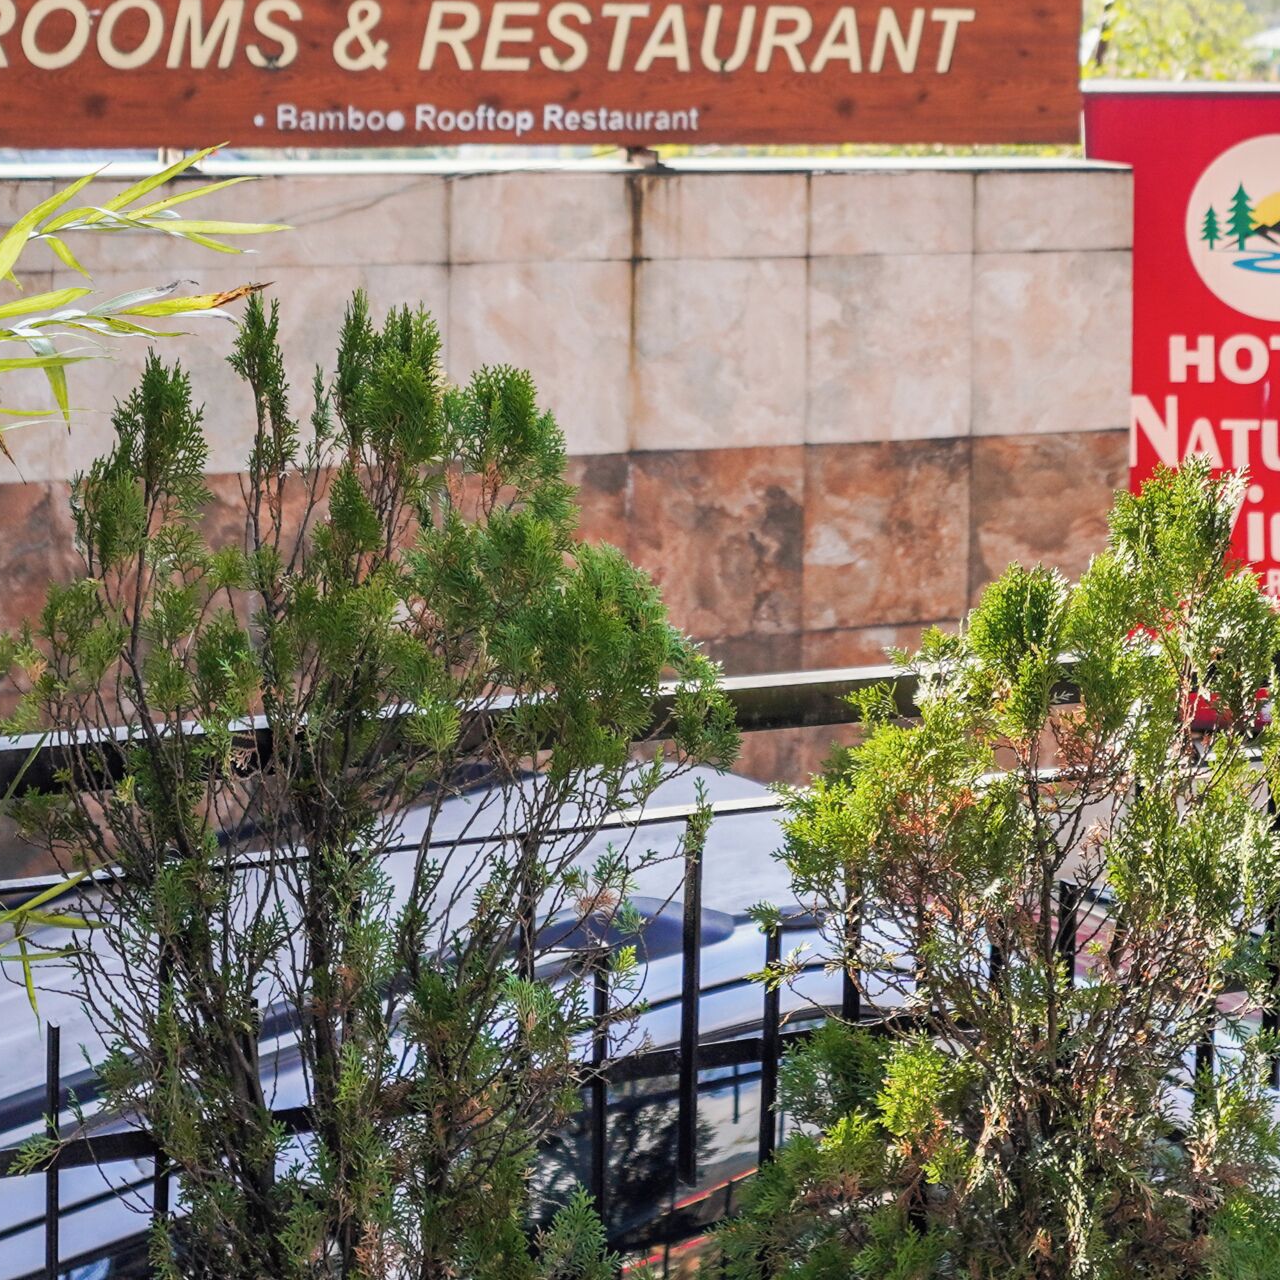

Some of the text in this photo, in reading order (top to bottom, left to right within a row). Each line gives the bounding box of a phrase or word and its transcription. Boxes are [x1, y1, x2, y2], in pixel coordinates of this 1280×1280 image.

[418, 0, 976, 74] RESTAURANT
[415, 104, 534, 136] Rooftop
[543, 104, 699, 132] Restaurant
